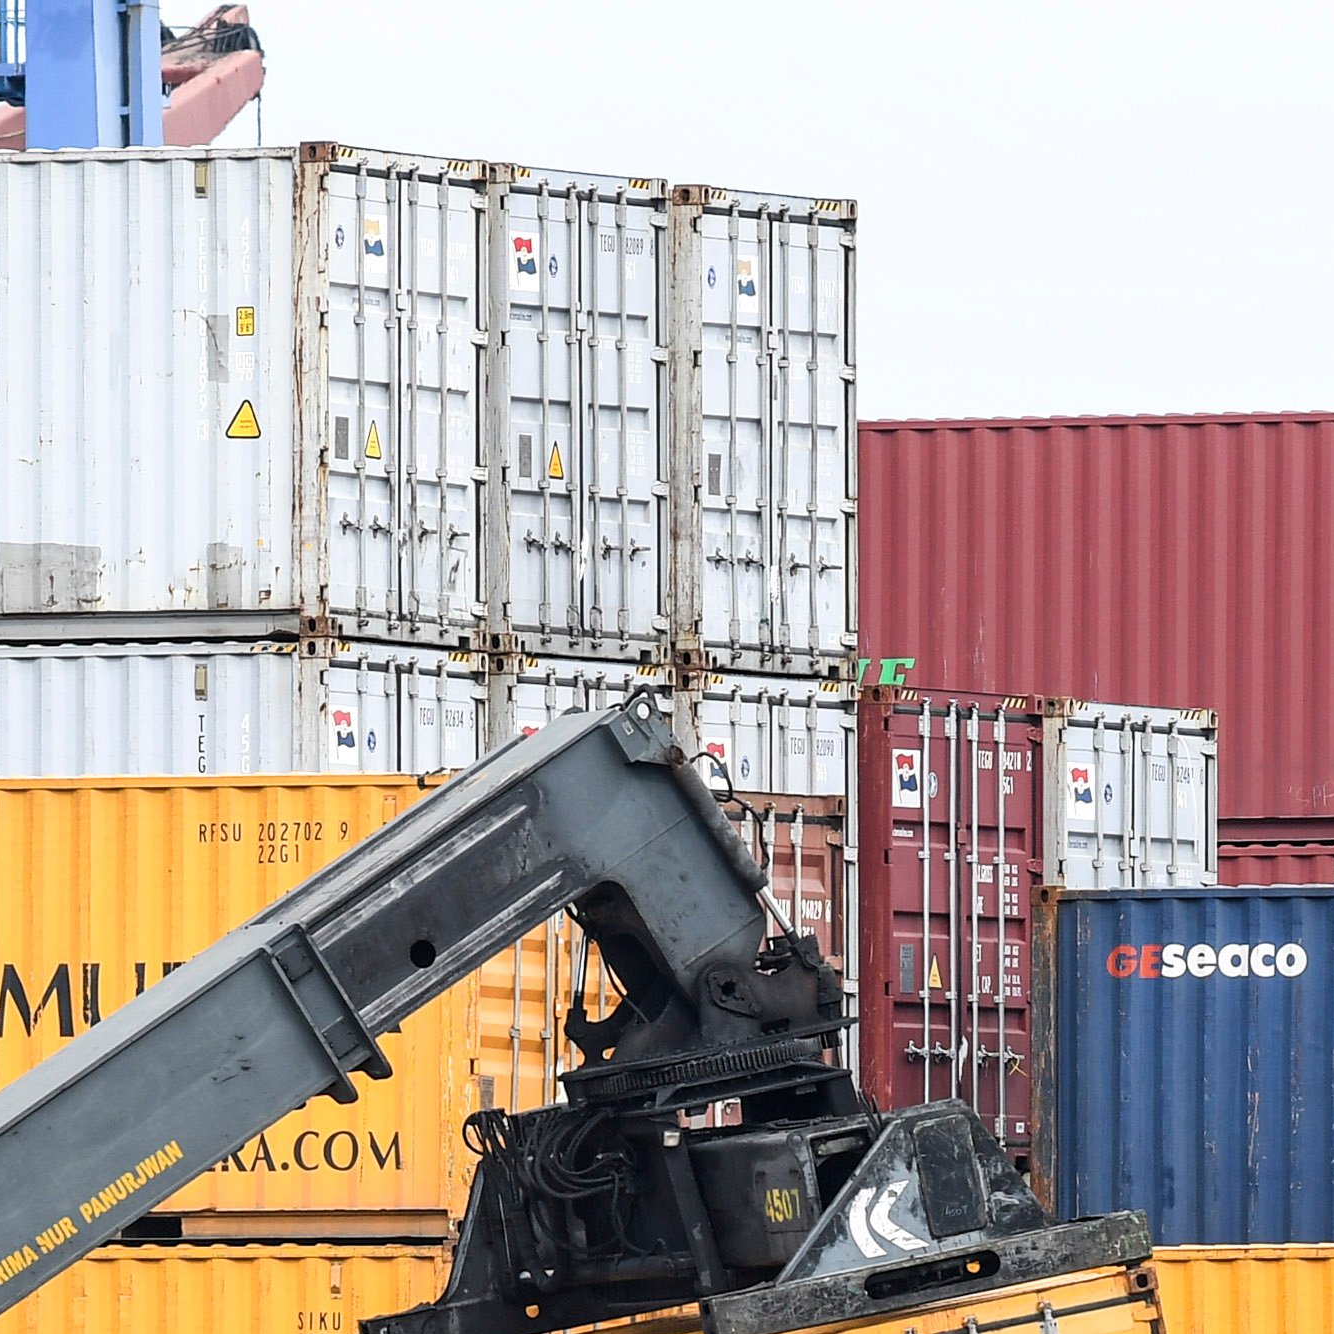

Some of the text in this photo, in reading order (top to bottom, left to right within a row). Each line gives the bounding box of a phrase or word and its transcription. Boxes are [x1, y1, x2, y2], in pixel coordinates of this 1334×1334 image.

[600, 234, 615, 254] TEGU
[978, 750, 993, 770] TEGU
[198, 821, 349, 843] RFSU 202702 9
[258, 844, 300, 864] 22G1
[764, 1188, 802, 1223] 4507
[36, 1217, 79, 1255] NUR
[297, 1312, 341, 1331] SIKU
